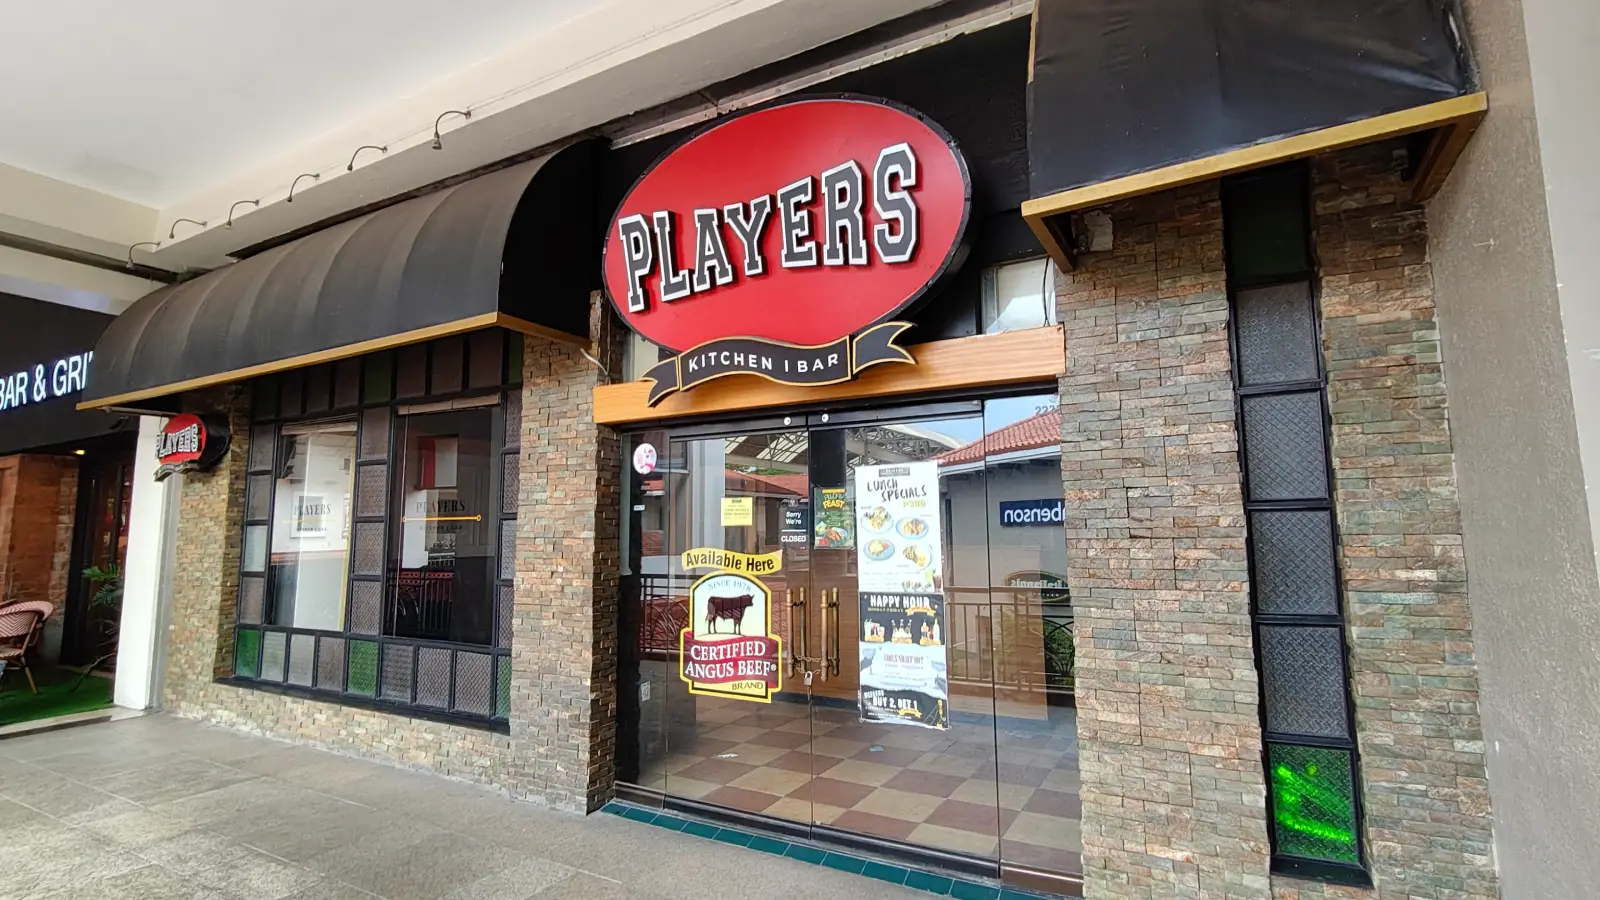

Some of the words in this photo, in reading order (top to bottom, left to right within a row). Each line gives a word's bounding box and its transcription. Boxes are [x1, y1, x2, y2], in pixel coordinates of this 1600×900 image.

[618, 142, 917, 314] PLAYERS
[688, 351, 773, 373] KITCHEN
[797, 353, 839, 373] BAR
[33, 363, 47, 402] &
[53, 350, 94, 397] GRI
[155, 423, 199, 459] PLAYERS
[867, 478, 898, 492] LUNCH
[881, 484, 927, 503] SPECIALS
[293, 503, 332, 516] PLAYERS
[415, 499, 466, 513] PLAYERS
[822, 499, 845, 509] FEAST
[686, 550, 743, 570] Available
[746, 557, 775, 572] Here
[707, 580, 730, 590] SINCE
[870, 594, 900, 607] HAPPY
[902, 596, 930, 609] HOUR
[690, 640, 766, 661] CERTIFIED
[684, 661, 734, 679] ANGUS
[732, 681, 764, 690] BRAND
[873, 696, 887, 707] BUY
